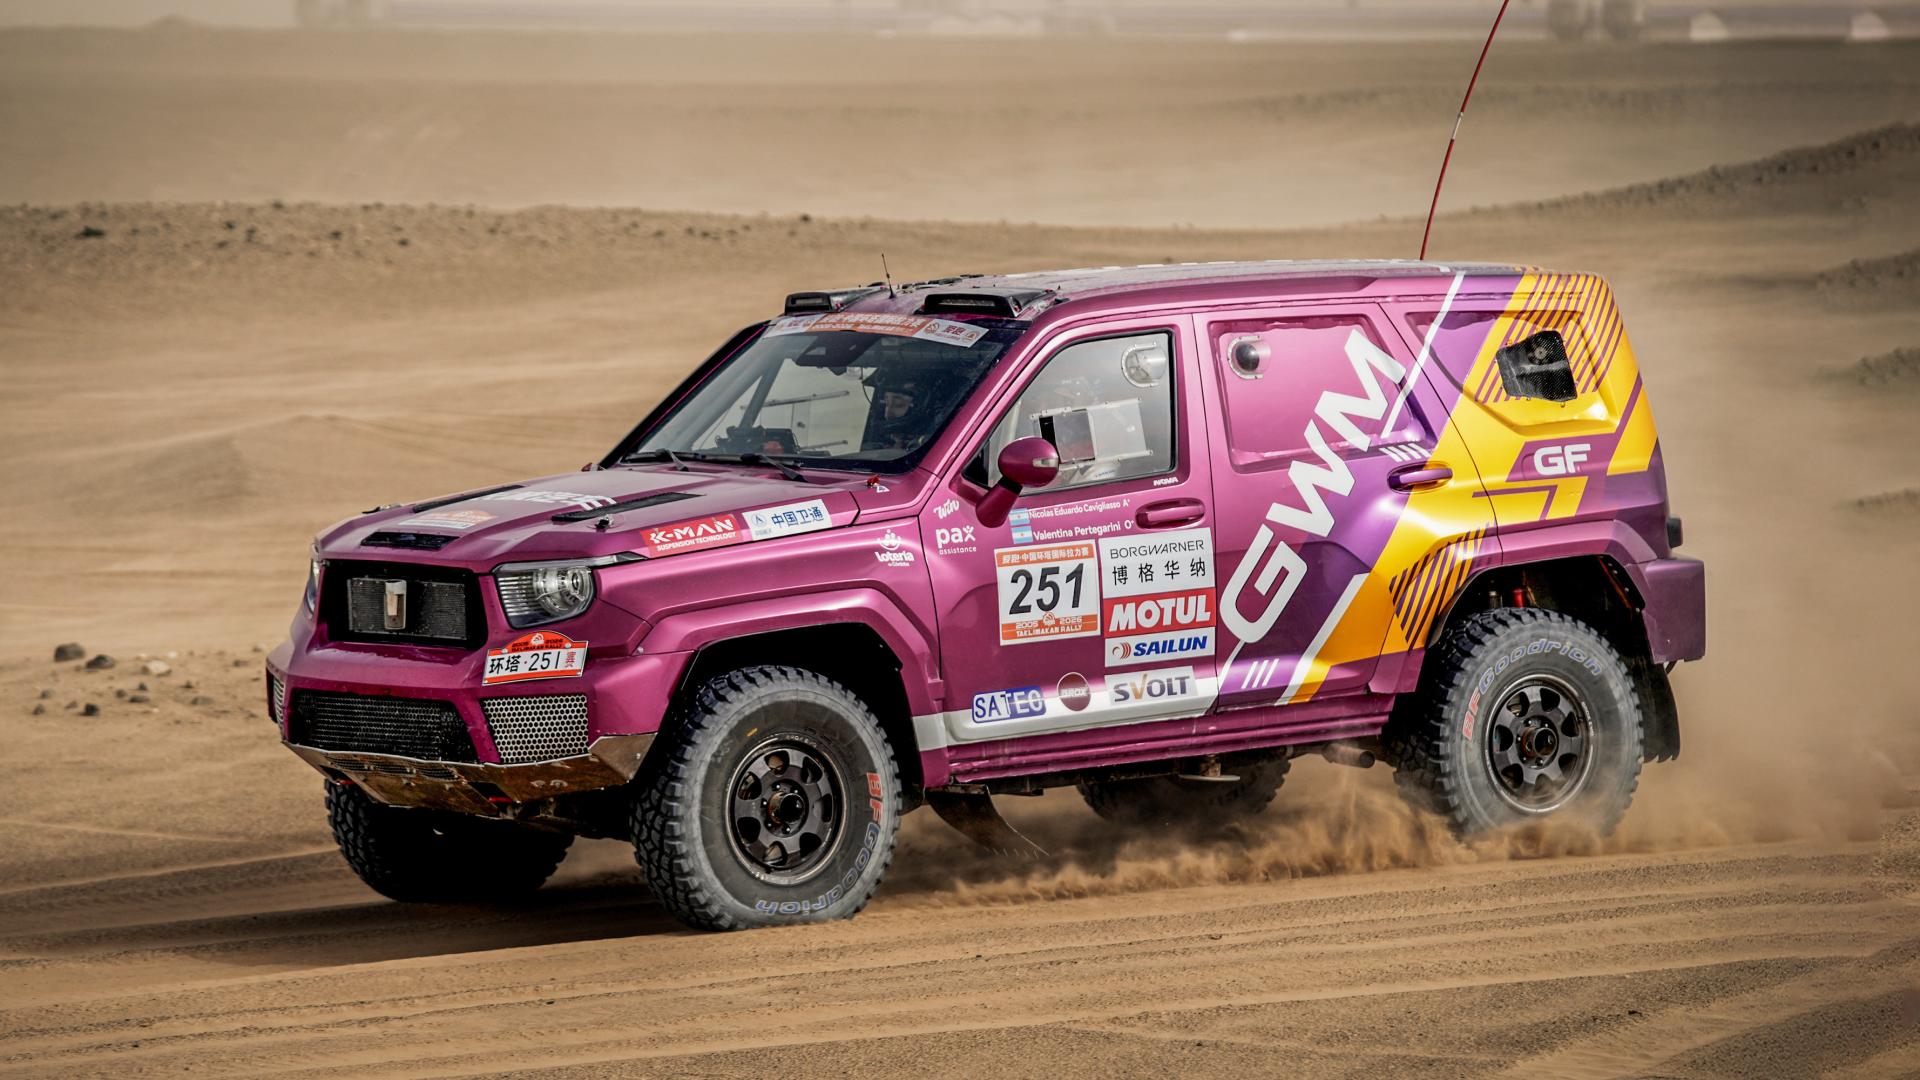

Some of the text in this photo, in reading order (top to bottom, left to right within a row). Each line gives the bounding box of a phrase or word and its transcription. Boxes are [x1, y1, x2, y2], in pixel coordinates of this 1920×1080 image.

[1534, 443, 1591, 475] GF
[1220, 329, 1407, 643] GWM
[771, 506, 824, 529] 中国卫通
[1028, 509, 1054, 519] Nicolas
[1055, 505, 1082, 516] Eduardo
[1083, 501, 1121, 514] Cavigliasso
[649, 518, 734, 545] K-MAN
[656, 531, 737, 551] SUSPENSION TECHNOLOGY
[935, 525, 976, 549] pax
[1034, 526, 1073, 541] Valentina
[1075, 521, 1121, 536] Pertegarini
[939, 546, 977, 555] assistance
[1110, 540, 1204, 559] BORGWARNER
[1112, 557, 1206, 586] 博格华纳
[1009, 563, 1084, 615] 251
[1109, 594, 1211, 632] MOTUL
[1060, 623, 1082, 633] RALLY
[1133, 636, 1207, 657] SAILUN
[1114, 673, 1190, 702] SVOLT
